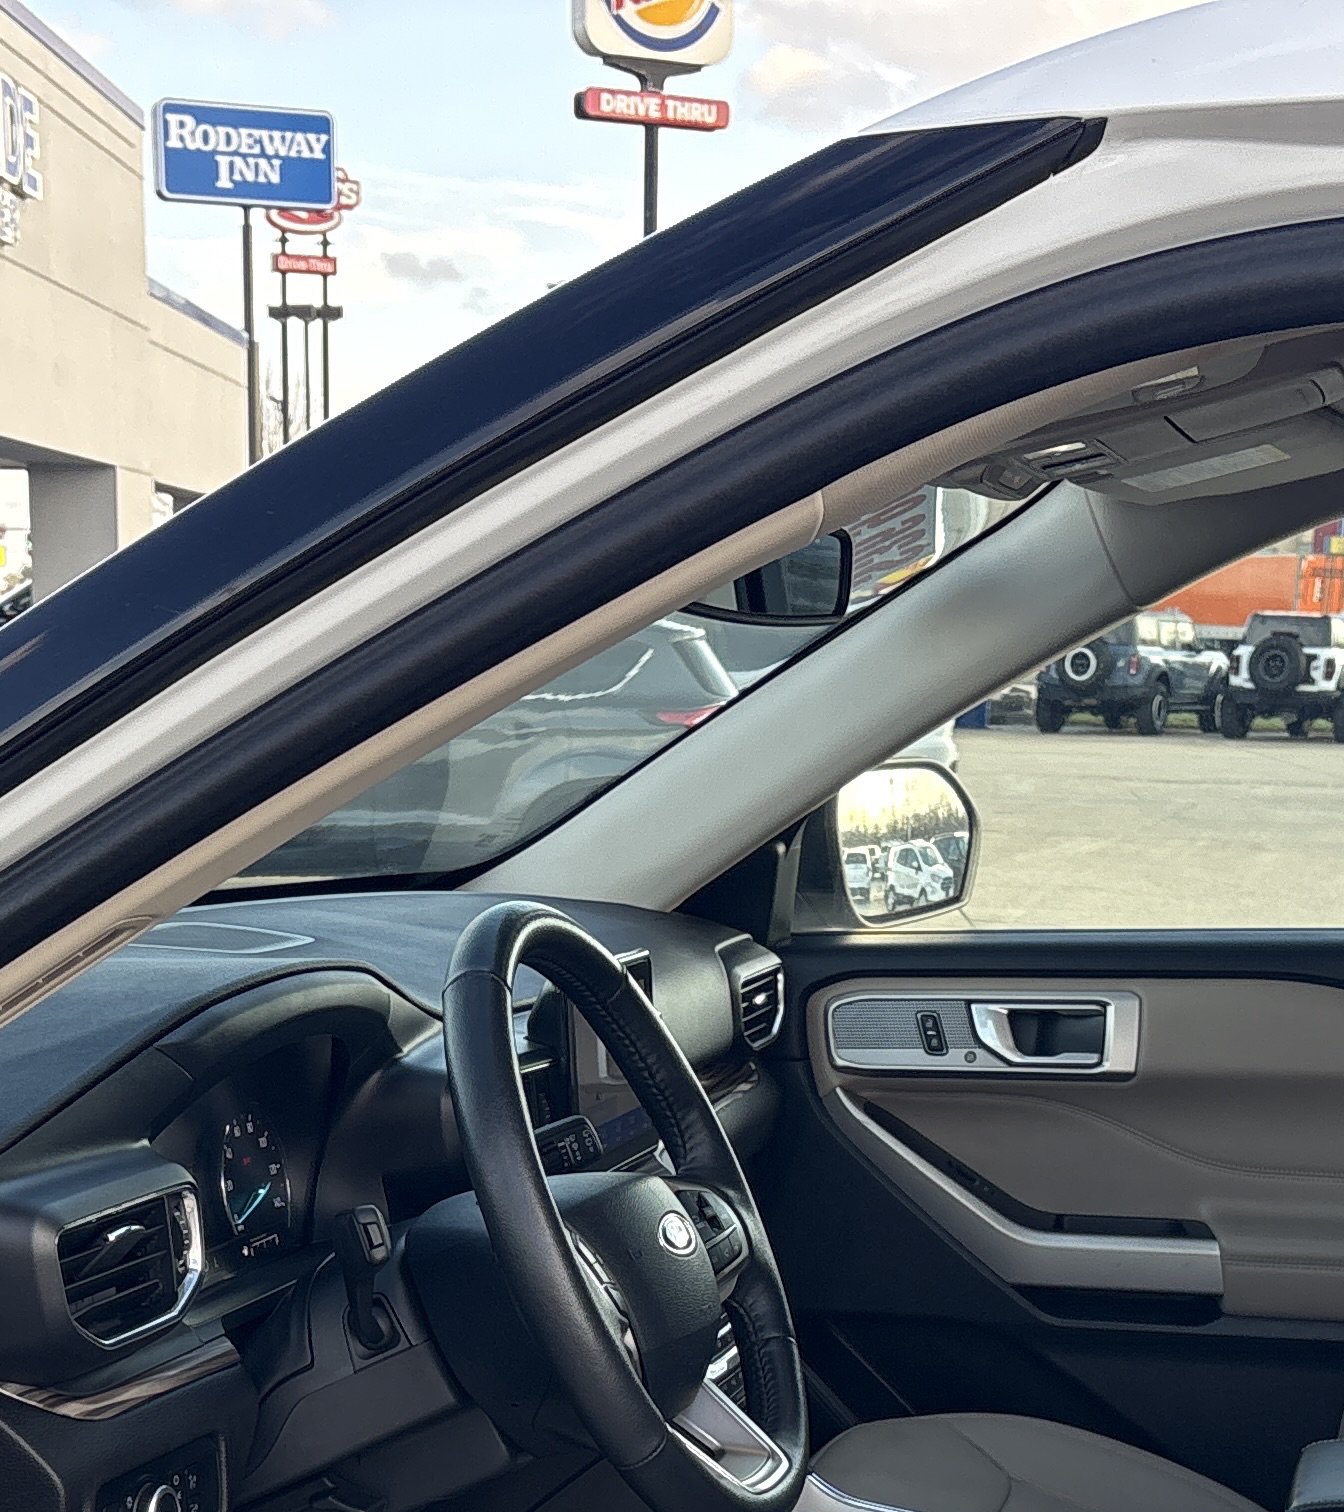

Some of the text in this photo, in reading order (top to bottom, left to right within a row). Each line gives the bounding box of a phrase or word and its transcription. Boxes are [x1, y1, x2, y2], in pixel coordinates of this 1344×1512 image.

[599, 92, 718, 123] DRIVE THRU
[165, 113, 330, 160] RODEWAY
[214, 154, 283, 189] INN
